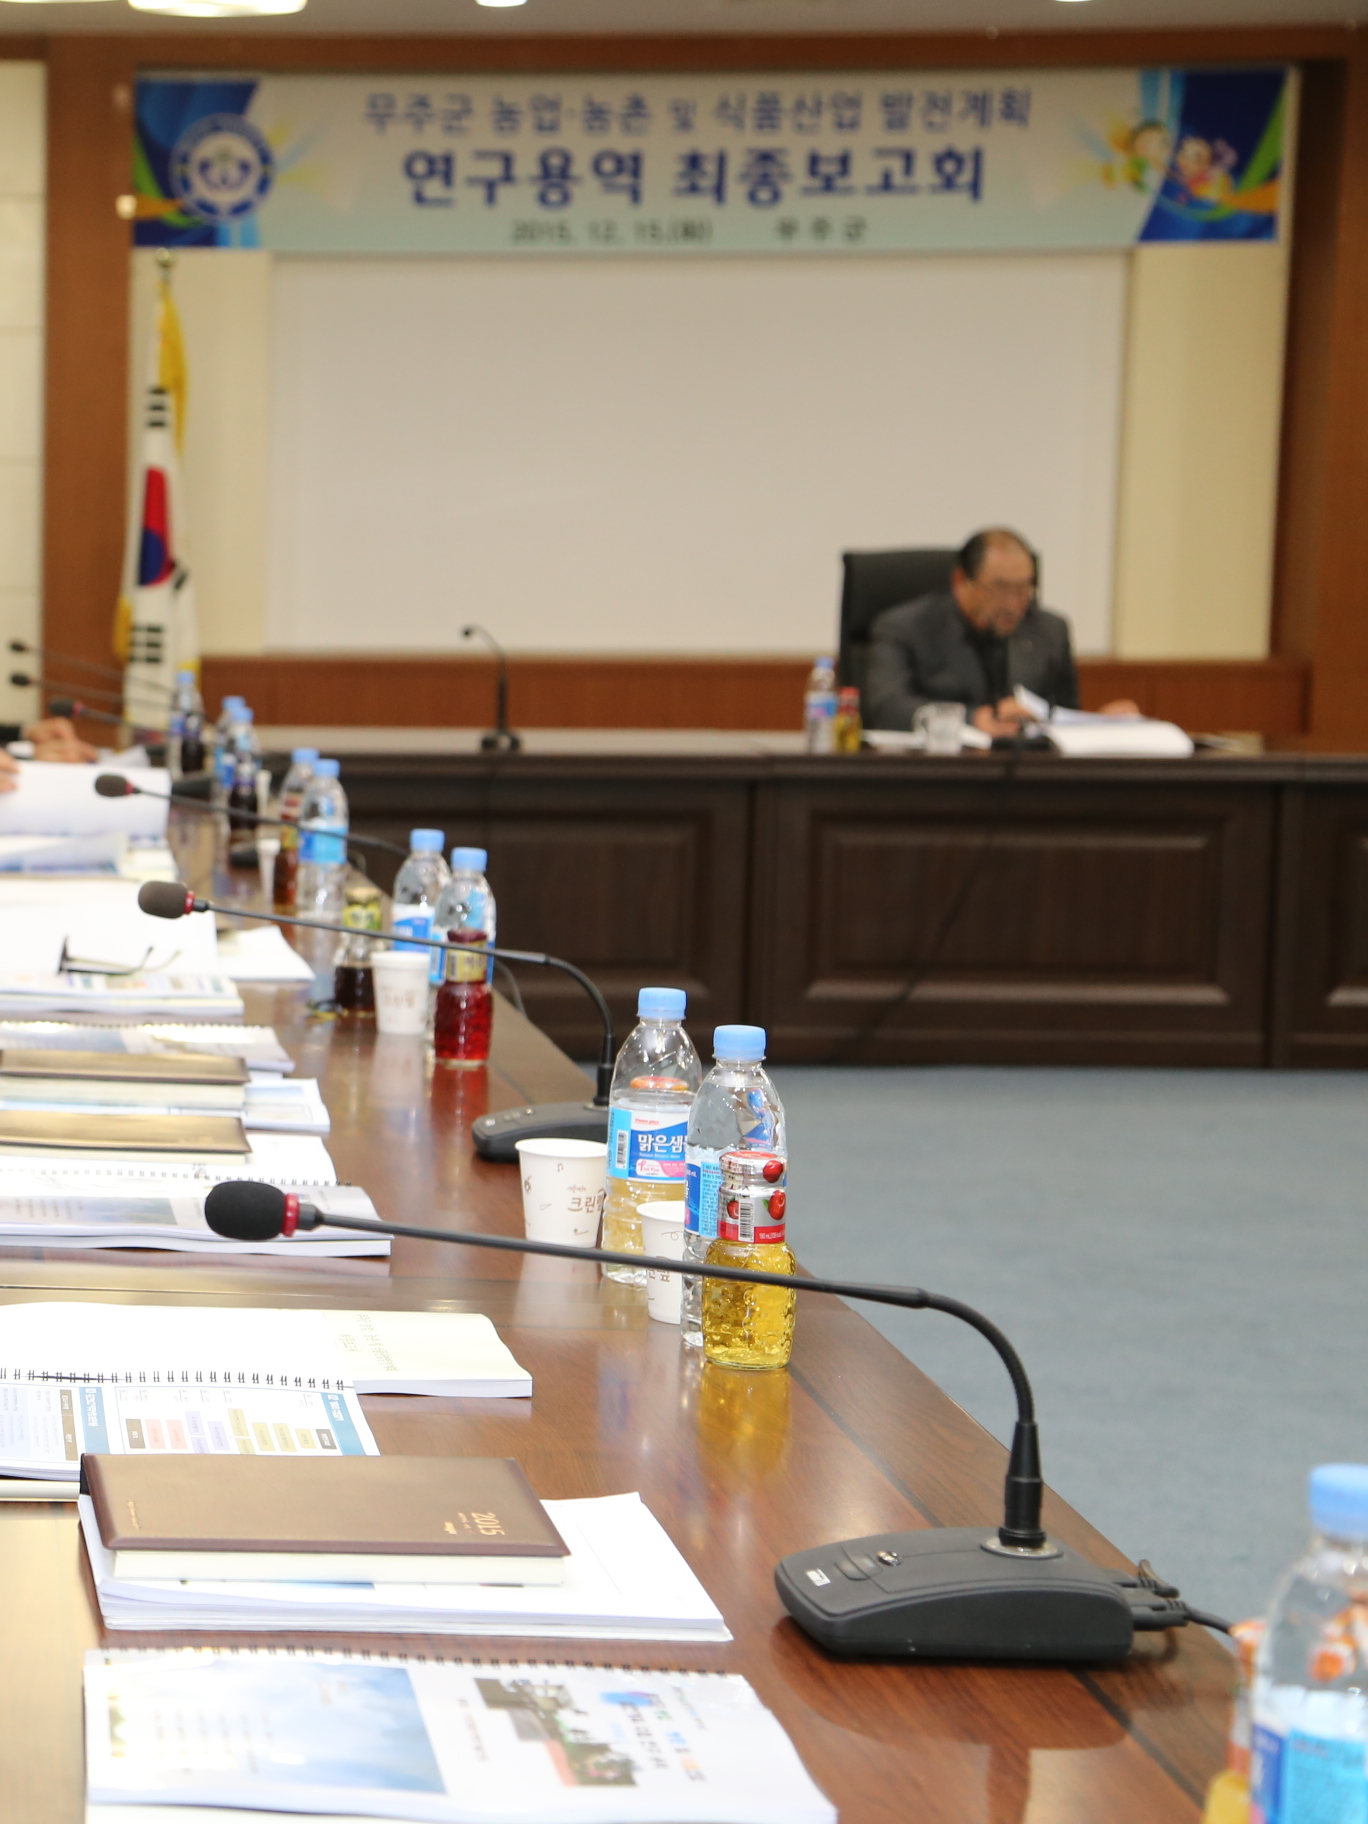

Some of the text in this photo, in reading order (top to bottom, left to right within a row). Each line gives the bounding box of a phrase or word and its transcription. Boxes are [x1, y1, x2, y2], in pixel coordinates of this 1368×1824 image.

[365, 92, 473, 136] 무주군
[713, 89, 863, 135] 식품산업
[879, 86, 1031, 133] 발전계획
[402, 144, 984, 210] 연구용역 최종보고회
[471, 1511, 506, 1536] 2015
